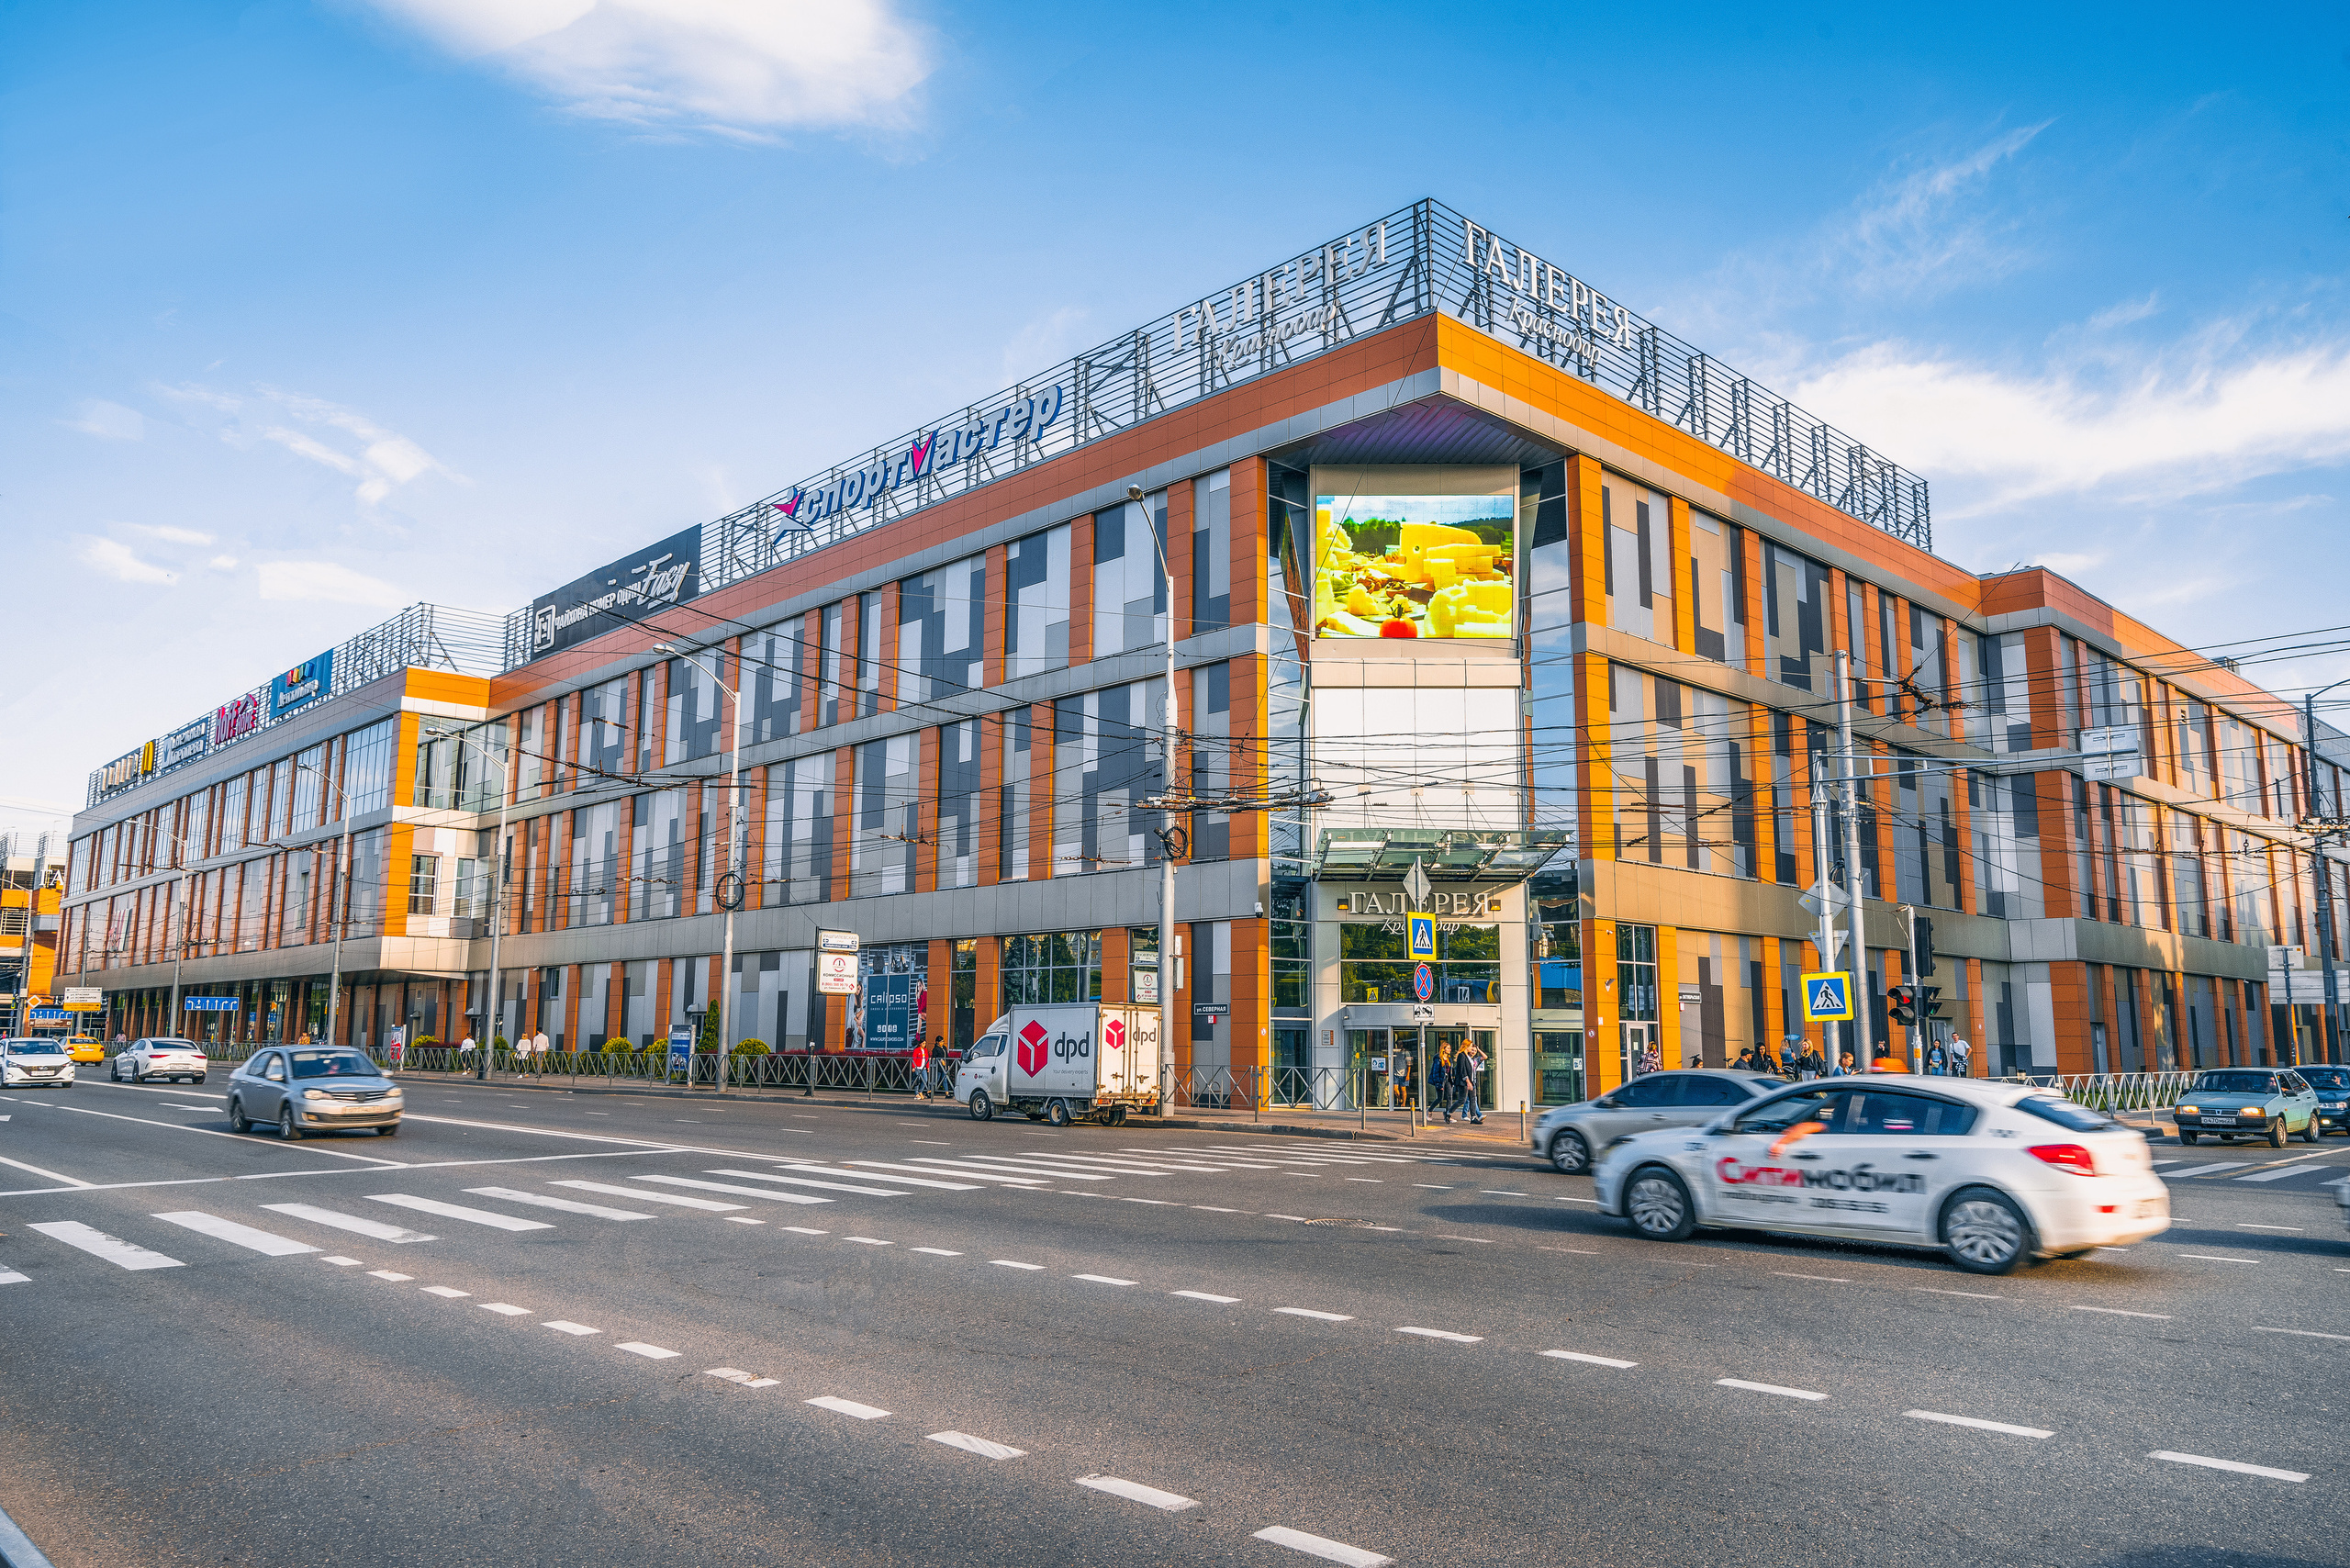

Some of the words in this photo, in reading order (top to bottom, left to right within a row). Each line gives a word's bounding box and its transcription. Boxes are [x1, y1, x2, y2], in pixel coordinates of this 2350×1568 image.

[1170, 219, 1390, 354] ГАЛЕРЕЯ
[1460, 218, 1632, 351] ГАЛЕРЕЯ
[1214, 305, 1337, 370] Краснодар
[1505, 296, 1601, 367] Краснодар
[555, 604, 588, 630] ЧАЙХОНА
[589, 592, 616, 616] НОМЕР
[617, 581, 642, 606] ОДИН
[637, 553, 690, 610] Easy
[238, 710, 257, 735] HOME
[1055, 1031, 1090, 1064] dpd
[1133, 1027, 1157, 1046] dpd
